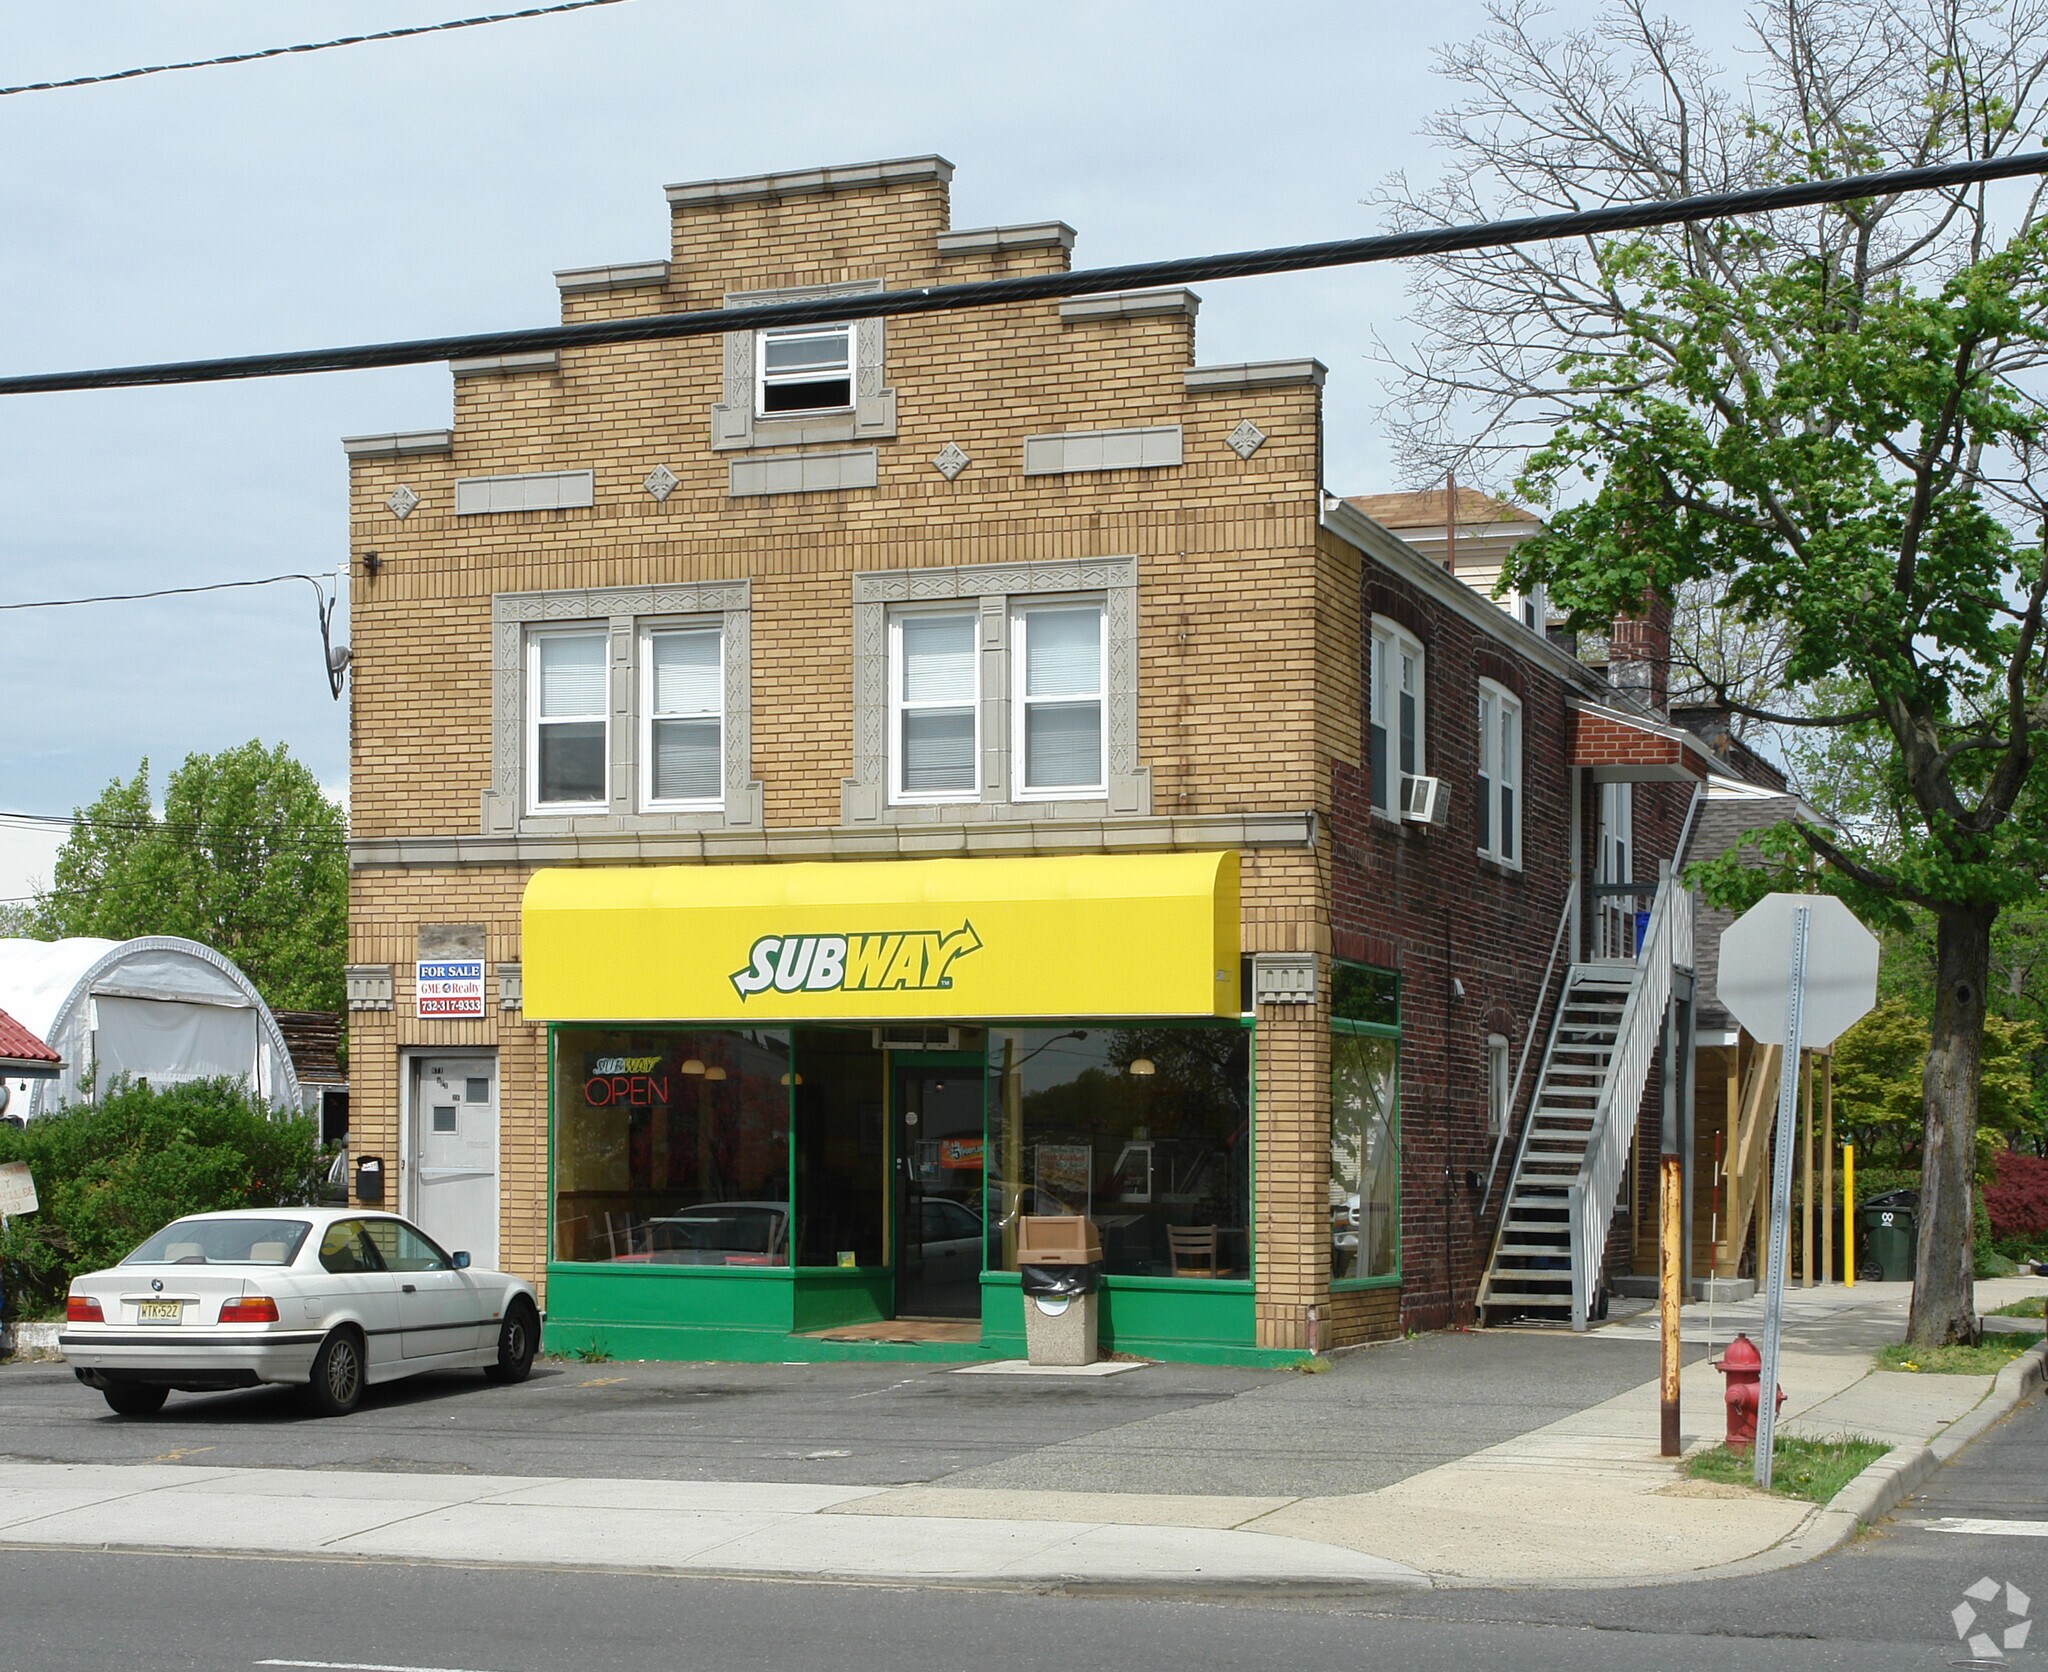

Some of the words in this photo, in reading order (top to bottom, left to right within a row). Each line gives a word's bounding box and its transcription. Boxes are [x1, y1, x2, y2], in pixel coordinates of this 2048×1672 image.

[731, 920, 981, 1001] SUBWAY
[421, 966, 446, 977] FOR
[448, 966, 480, 977] SALE
[421, 983, 441, 994] GME
[452, 982, 480, 995] Realty
[421, 1000, 480, 1011] 732-317-9333
[593, 1056, 662, 1075] SUBWAY
[584, 1076, 669, 1106] OPEN
